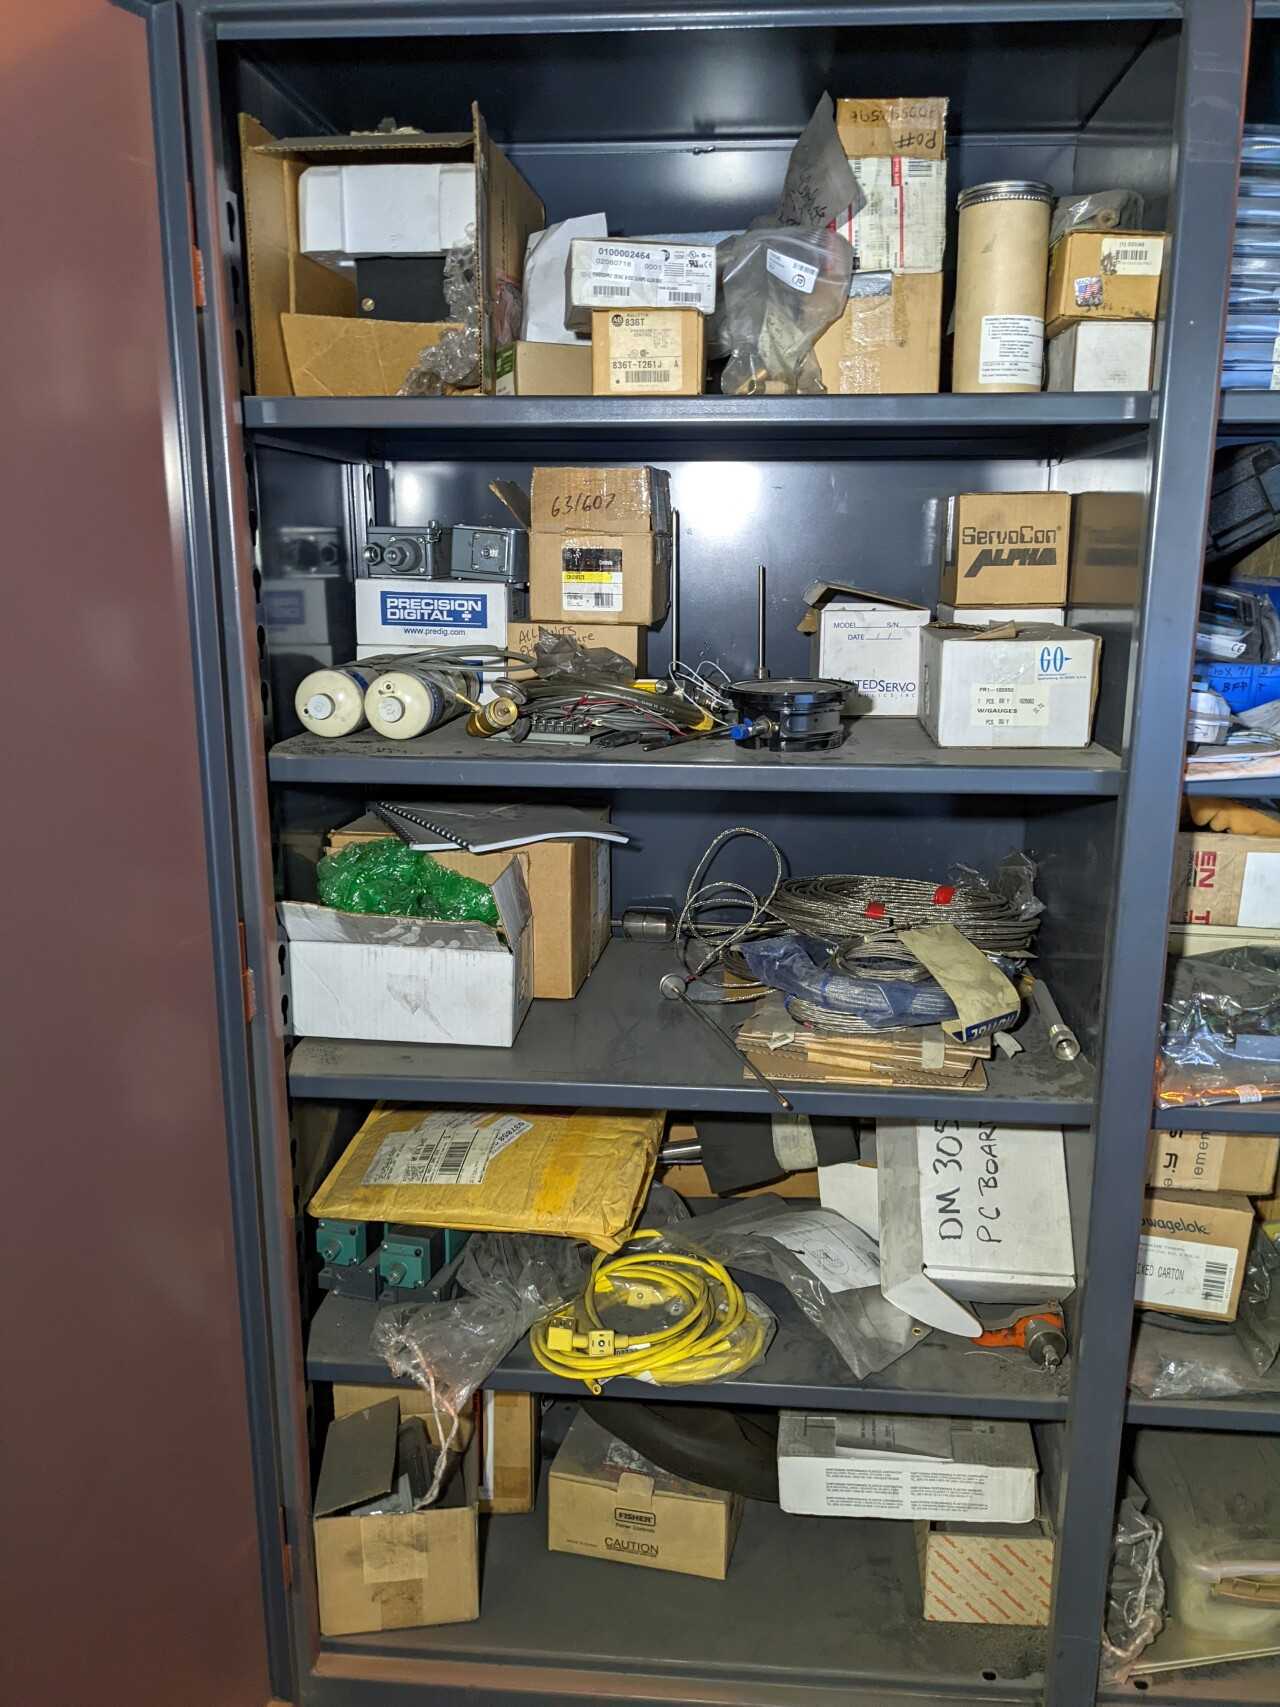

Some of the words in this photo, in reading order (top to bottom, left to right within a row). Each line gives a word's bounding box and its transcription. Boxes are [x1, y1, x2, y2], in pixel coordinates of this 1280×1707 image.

[598, 247, 650, 260] 0100002464
[962, 526, 1057, 545] ServoCon
[963, 547, 1057, 577] ALPHA
[386, 599, 482, 612] PRECISION
[386, 608, 454, 621] DIGITAL
[403, 627, 466, 637] www.predig.com
[833, 621, 857, 629] MODEL
[847, 633, 865, 641] DATE
[1040, 646, 1064, 673] GO
[935, 1186, 963, 1240] DM
[976, 1206, 1002, 1243] PC
[1157, 1265, 1185, 1281] CARTON
[618, 1511, 653, 1524] FISHER
[604, 1537, 659, 1555] CAUTION
